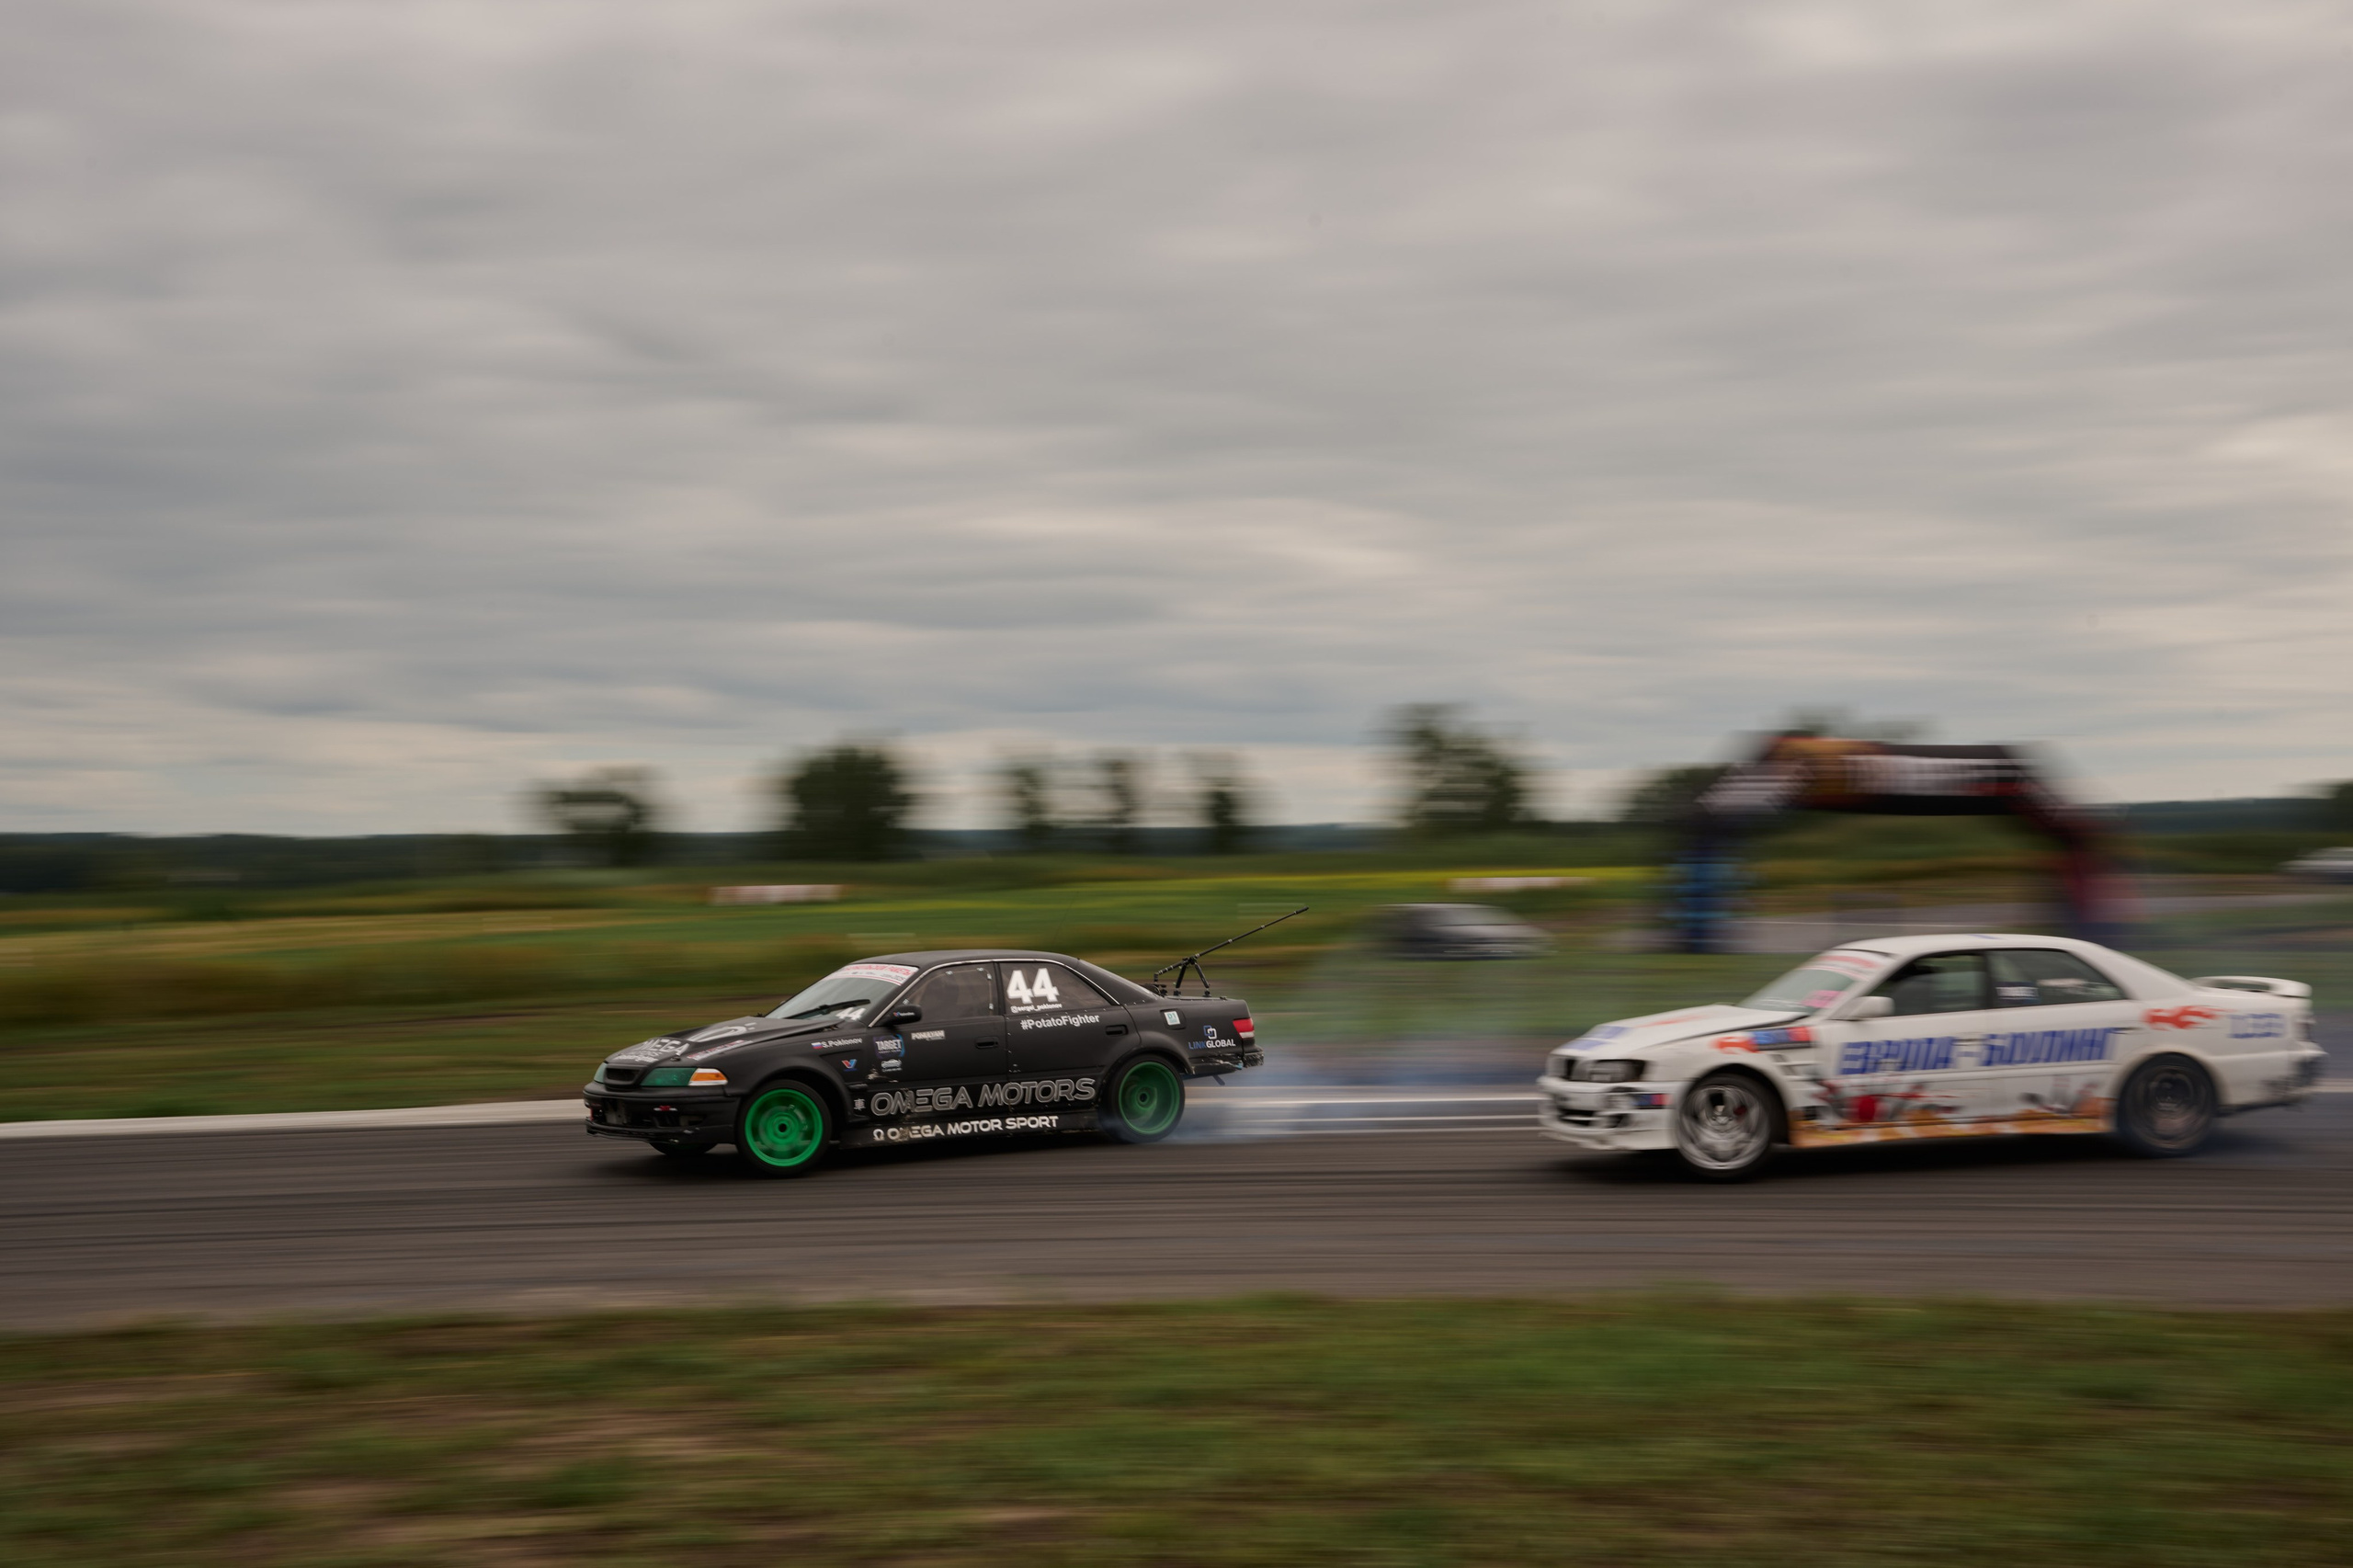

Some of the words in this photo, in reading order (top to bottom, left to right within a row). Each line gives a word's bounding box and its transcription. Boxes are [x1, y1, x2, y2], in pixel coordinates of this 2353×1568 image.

[1006, 968, 1060, 1005] 44
[835, 1007, 866, 1020] 44
[1020, 1014, 1100, 1030] #PotatoFighter
[632, 1039, 690, 1056] MEGA
[875, 1040, 902, 1051] TARGET
[870, 1086, 973, 1116] OMEGA
[977, 1078, 1096, 1108] MOTORS
[947, 1119, 1003, 1135] MOTOR
[1006, 1116, 1059, 1130] SPORT
